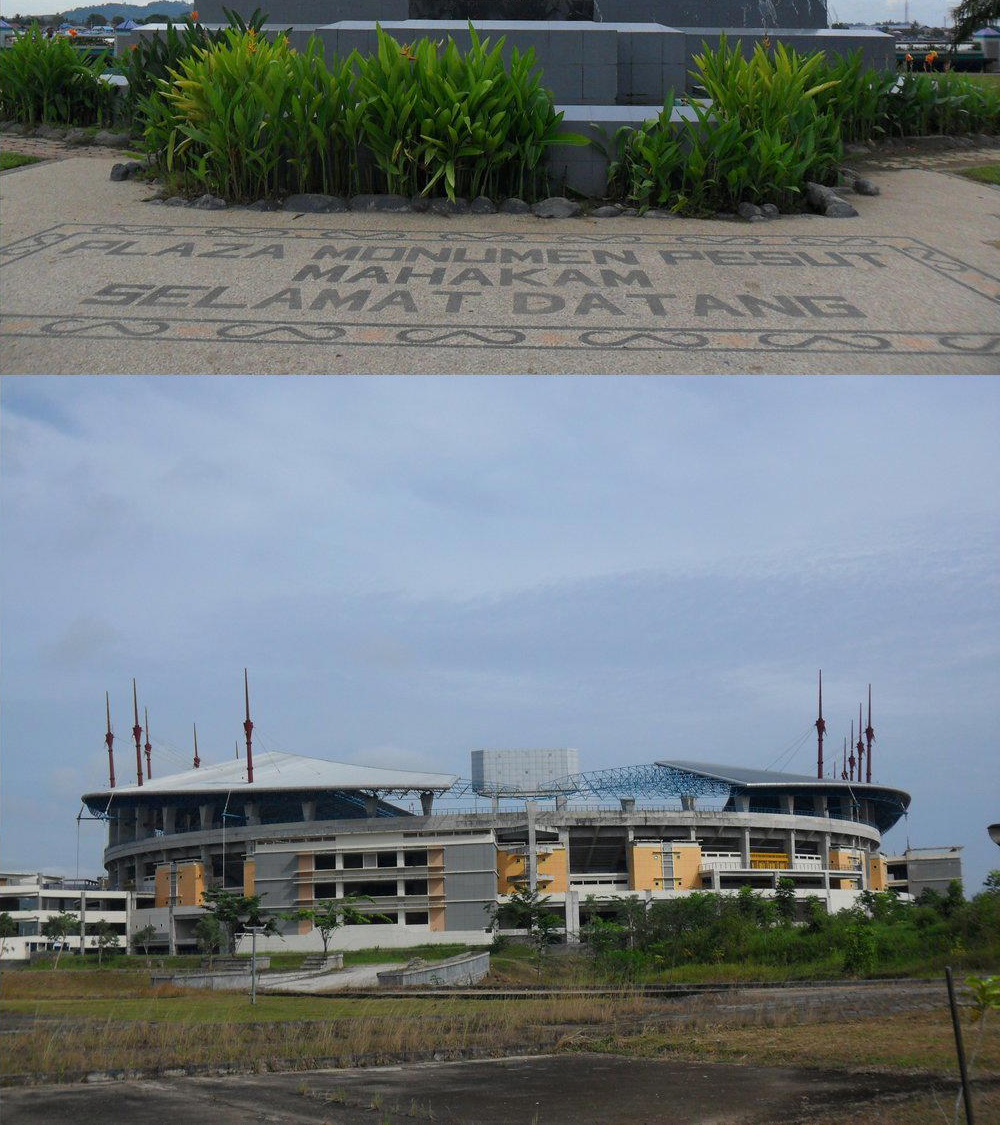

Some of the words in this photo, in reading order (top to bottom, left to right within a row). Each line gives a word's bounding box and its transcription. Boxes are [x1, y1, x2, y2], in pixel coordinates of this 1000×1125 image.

[62, 240, 286, 260] PLAZA
[310, 245, 638, 265] MONUMEN
[659, 250, 888, 268] PESUT
[292, 264, 652, 288] MAHAKAM
[79, 283, 482, 313] SELAMAT
[512, 291, 868, 319] DATANG
